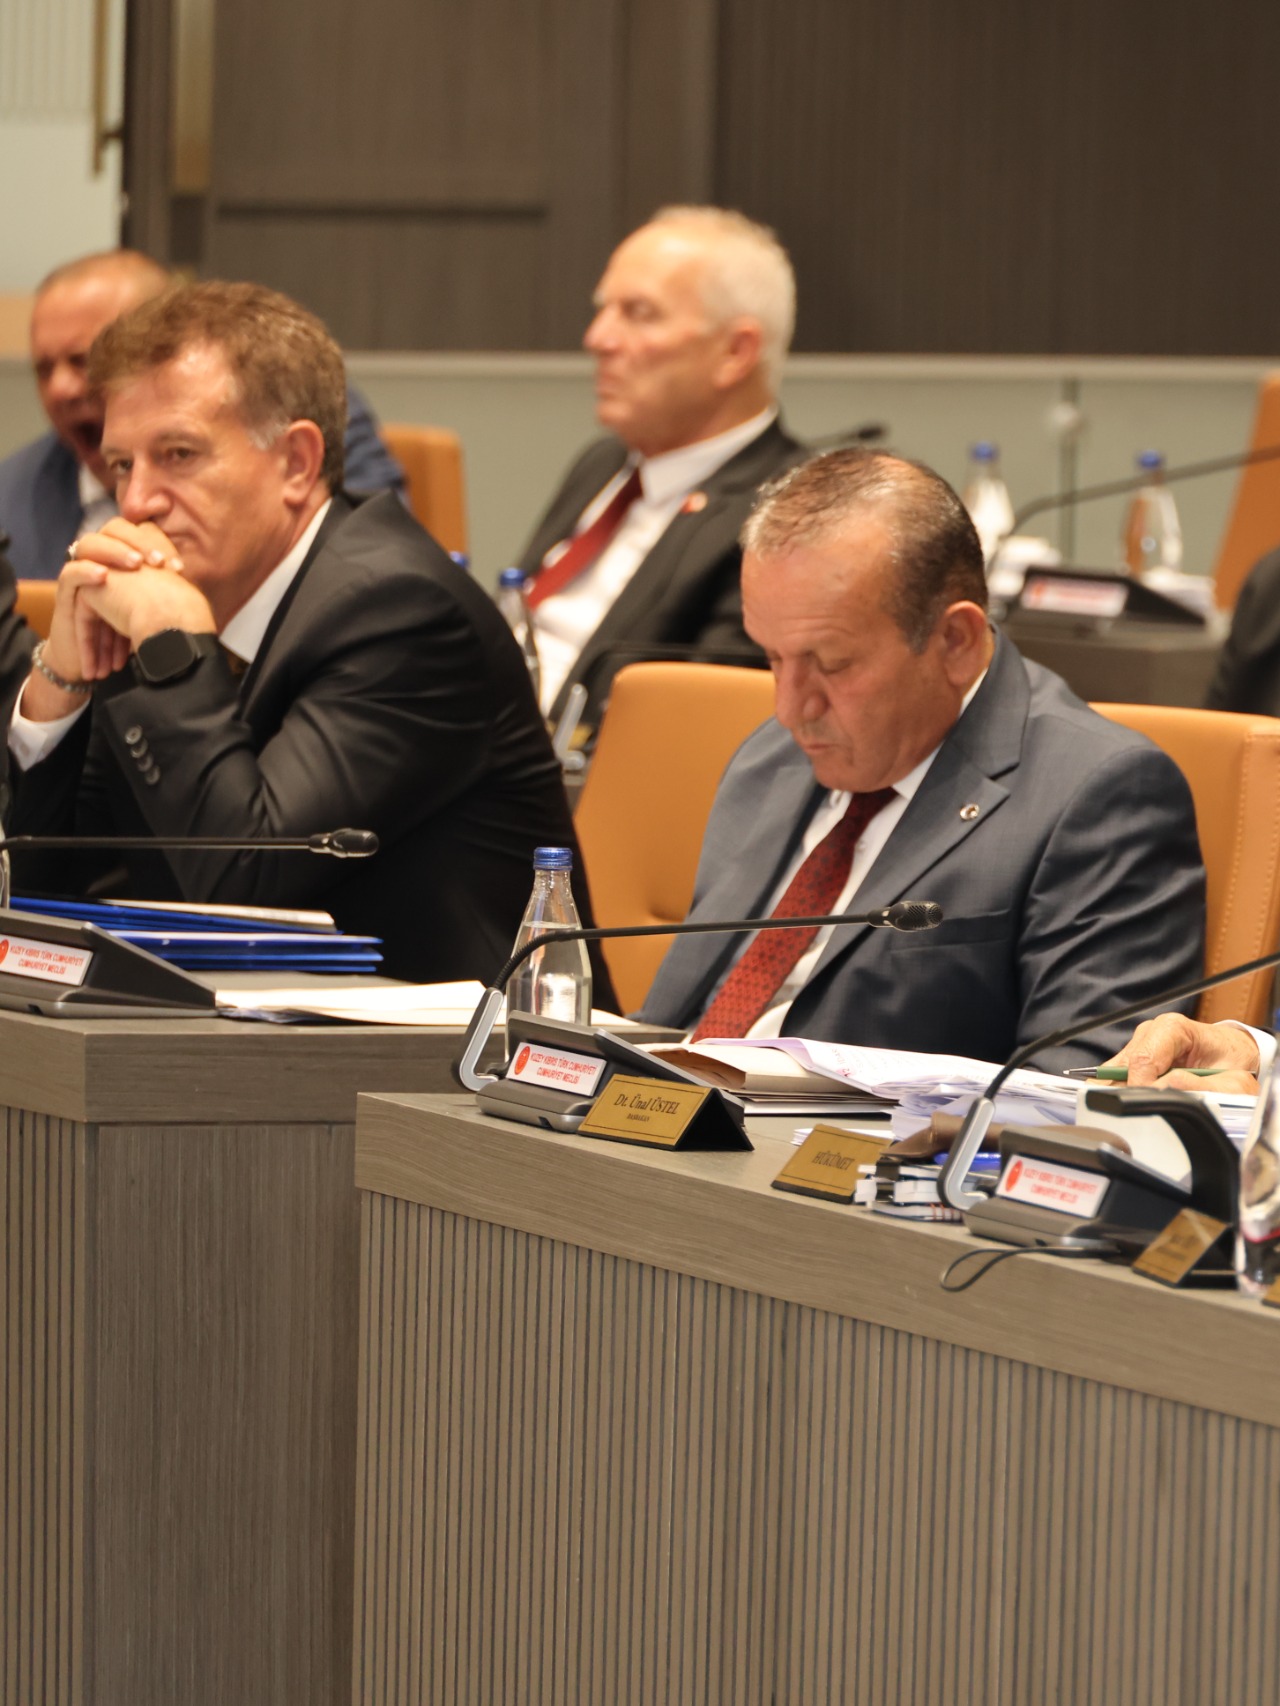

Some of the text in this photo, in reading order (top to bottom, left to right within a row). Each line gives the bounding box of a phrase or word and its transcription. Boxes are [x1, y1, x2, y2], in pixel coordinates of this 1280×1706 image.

[614, 1092, 681, 1115] Dt. Ünal ÜSTEL
[811, 1150, 856, 1171] HÜKÜMET
